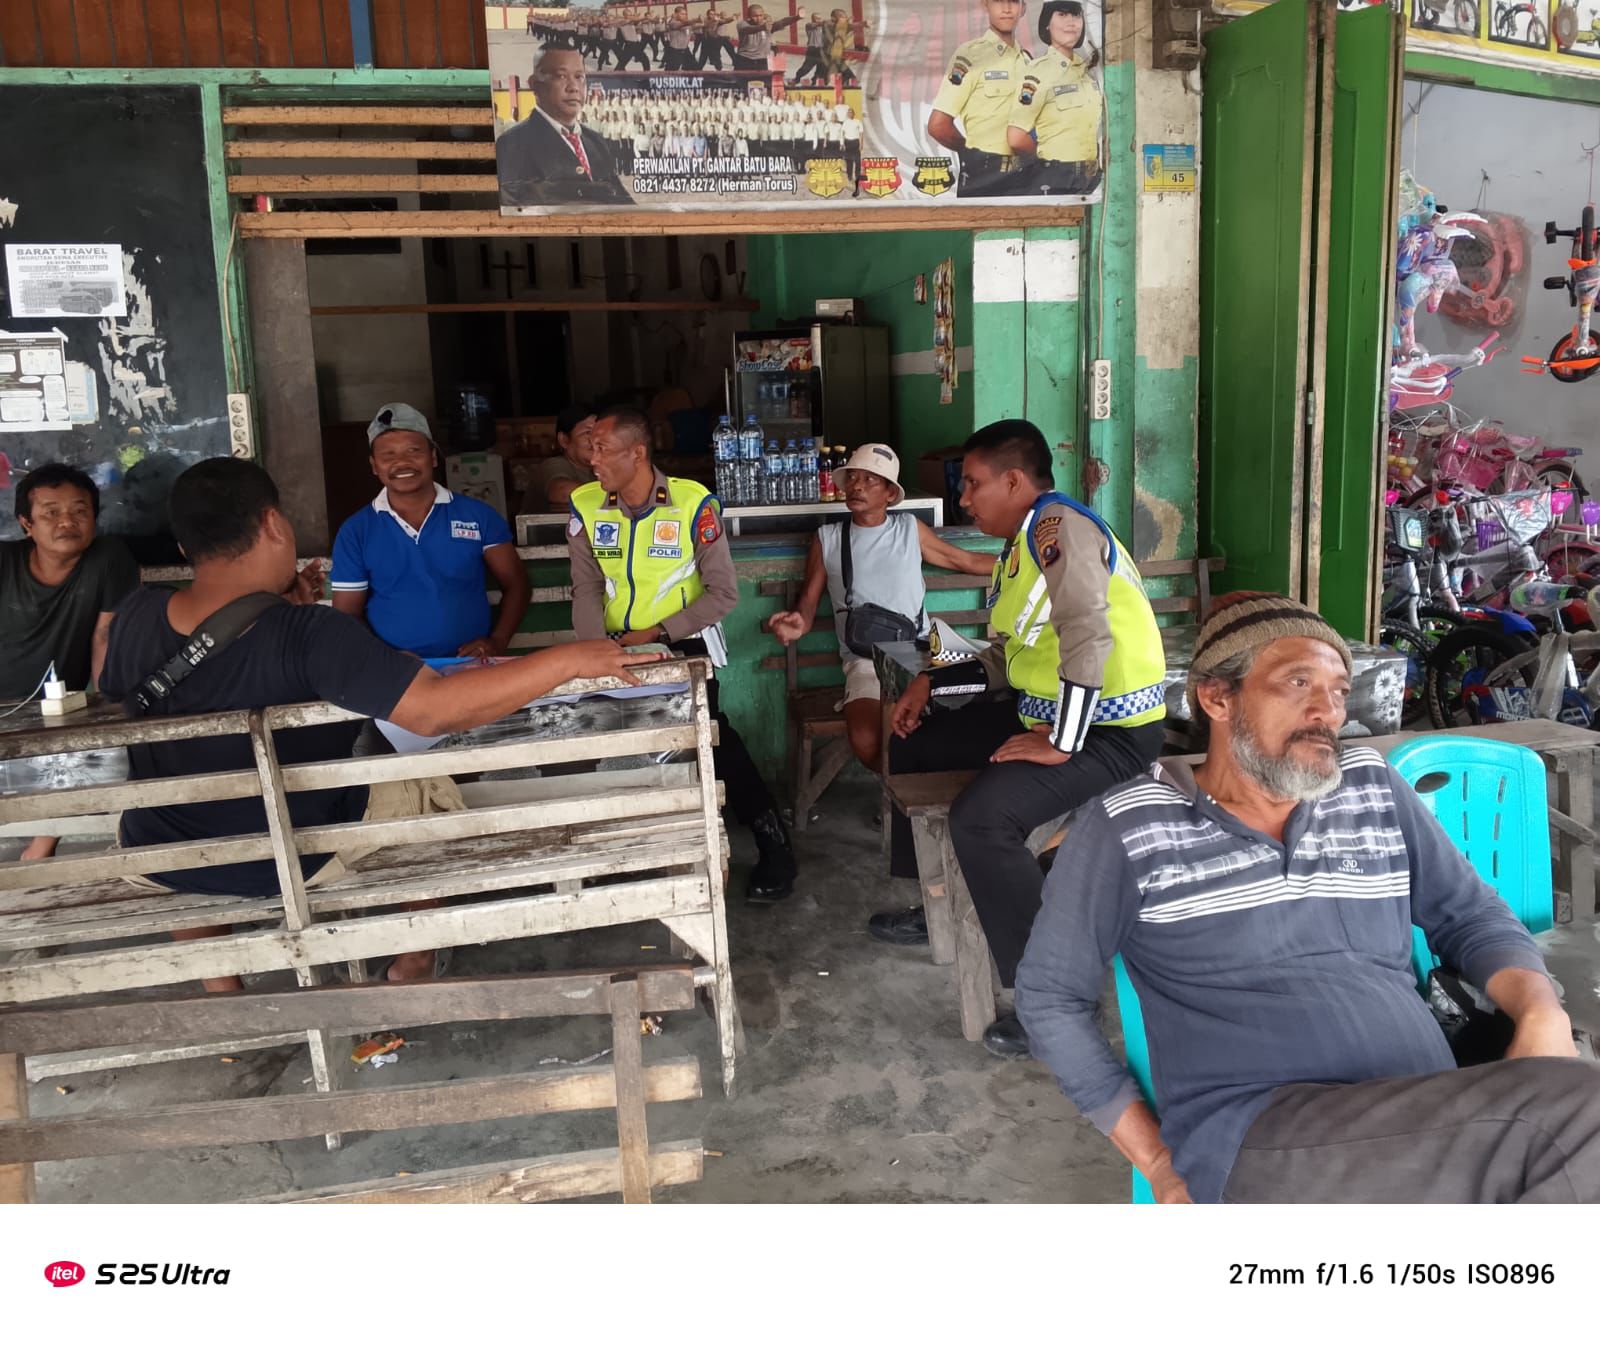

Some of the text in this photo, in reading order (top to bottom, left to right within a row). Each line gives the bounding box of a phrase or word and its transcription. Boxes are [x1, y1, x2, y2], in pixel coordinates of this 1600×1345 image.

[650, 77, 704, 88] PUSDIKLAT
[633, 156, 792, 174] PERWAKILAN PT. GANTAR BATU BARA
[1172, 173, 1185, 183] 45
[633, 175, 797, 194] 0821 4437 8272 (Herman Torus)
[16, 247, 108, 256] BARAT TRAVEL
[649, 548, 681, 556] POLRI
